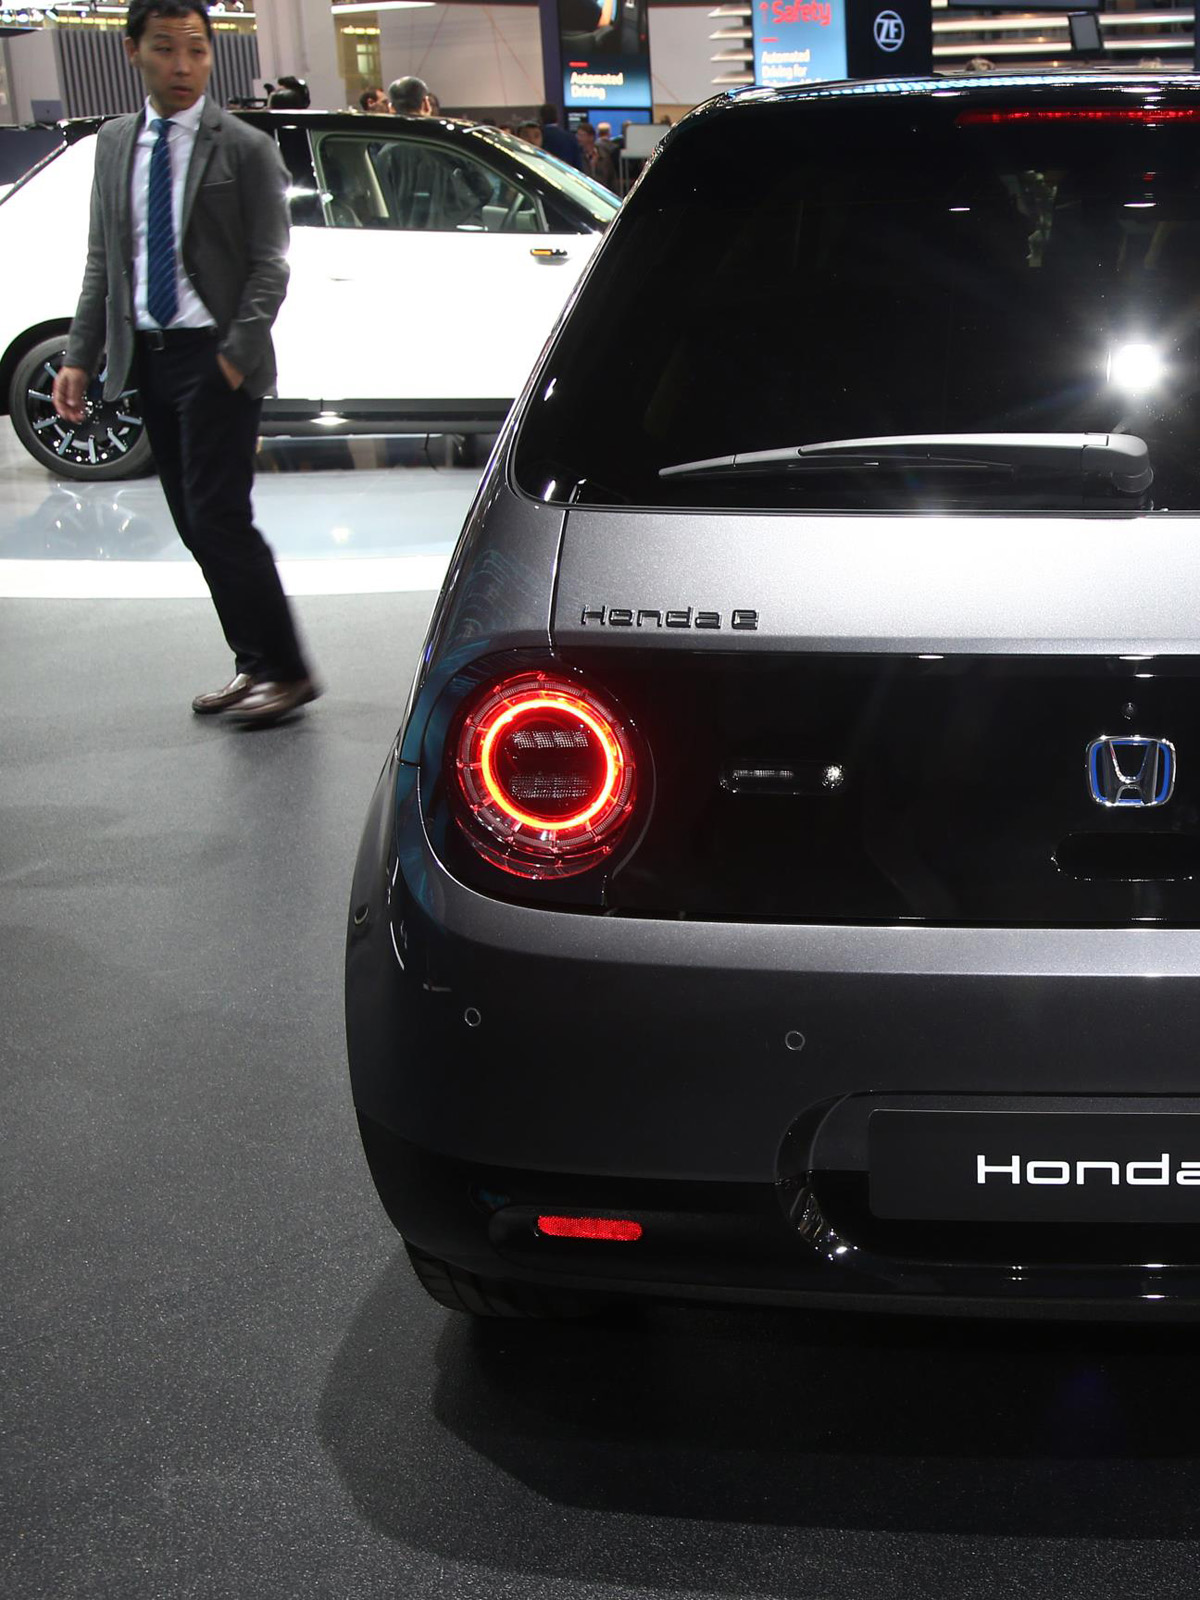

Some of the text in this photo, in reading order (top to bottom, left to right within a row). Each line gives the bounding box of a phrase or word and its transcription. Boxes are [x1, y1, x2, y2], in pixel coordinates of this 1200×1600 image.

[772, 0, 831, 26] Safety
[876, 17, 903, 44] ZF
[762, 49, 810, 63] Automated
[570, 71, 624, 86] Automated
[762, 65, 793, 79] Driving
[570, 84, 606, 100] Driving
[580, 604, 723, 629] Honda
